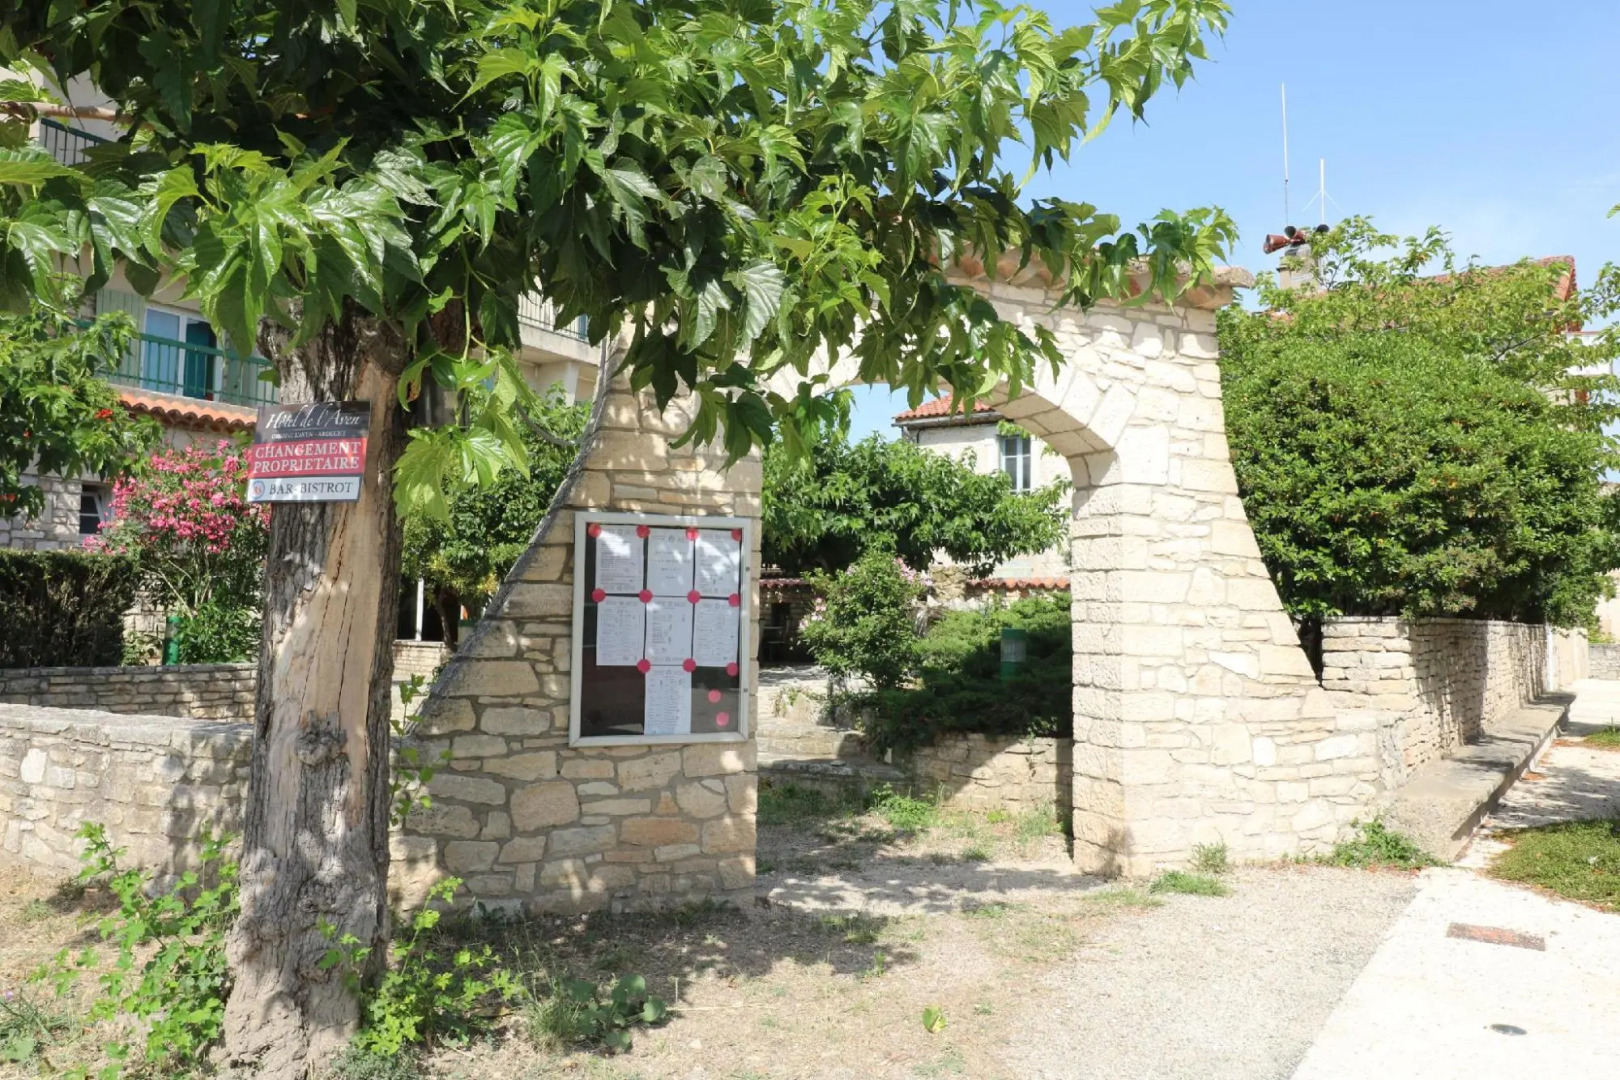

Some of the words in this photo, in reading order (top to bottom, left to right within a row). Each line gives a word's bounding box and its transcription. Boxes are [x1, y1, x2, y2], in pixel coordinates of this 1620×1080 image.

[300, 403, 319, 428] de
[255, 441, 361, 459] CHANGEMENT
[253, 456, 360, 474] PROPRIETAIRE
[269, 483, 294, 495] BAR
[301, 482, 354, 493] BISTROT
